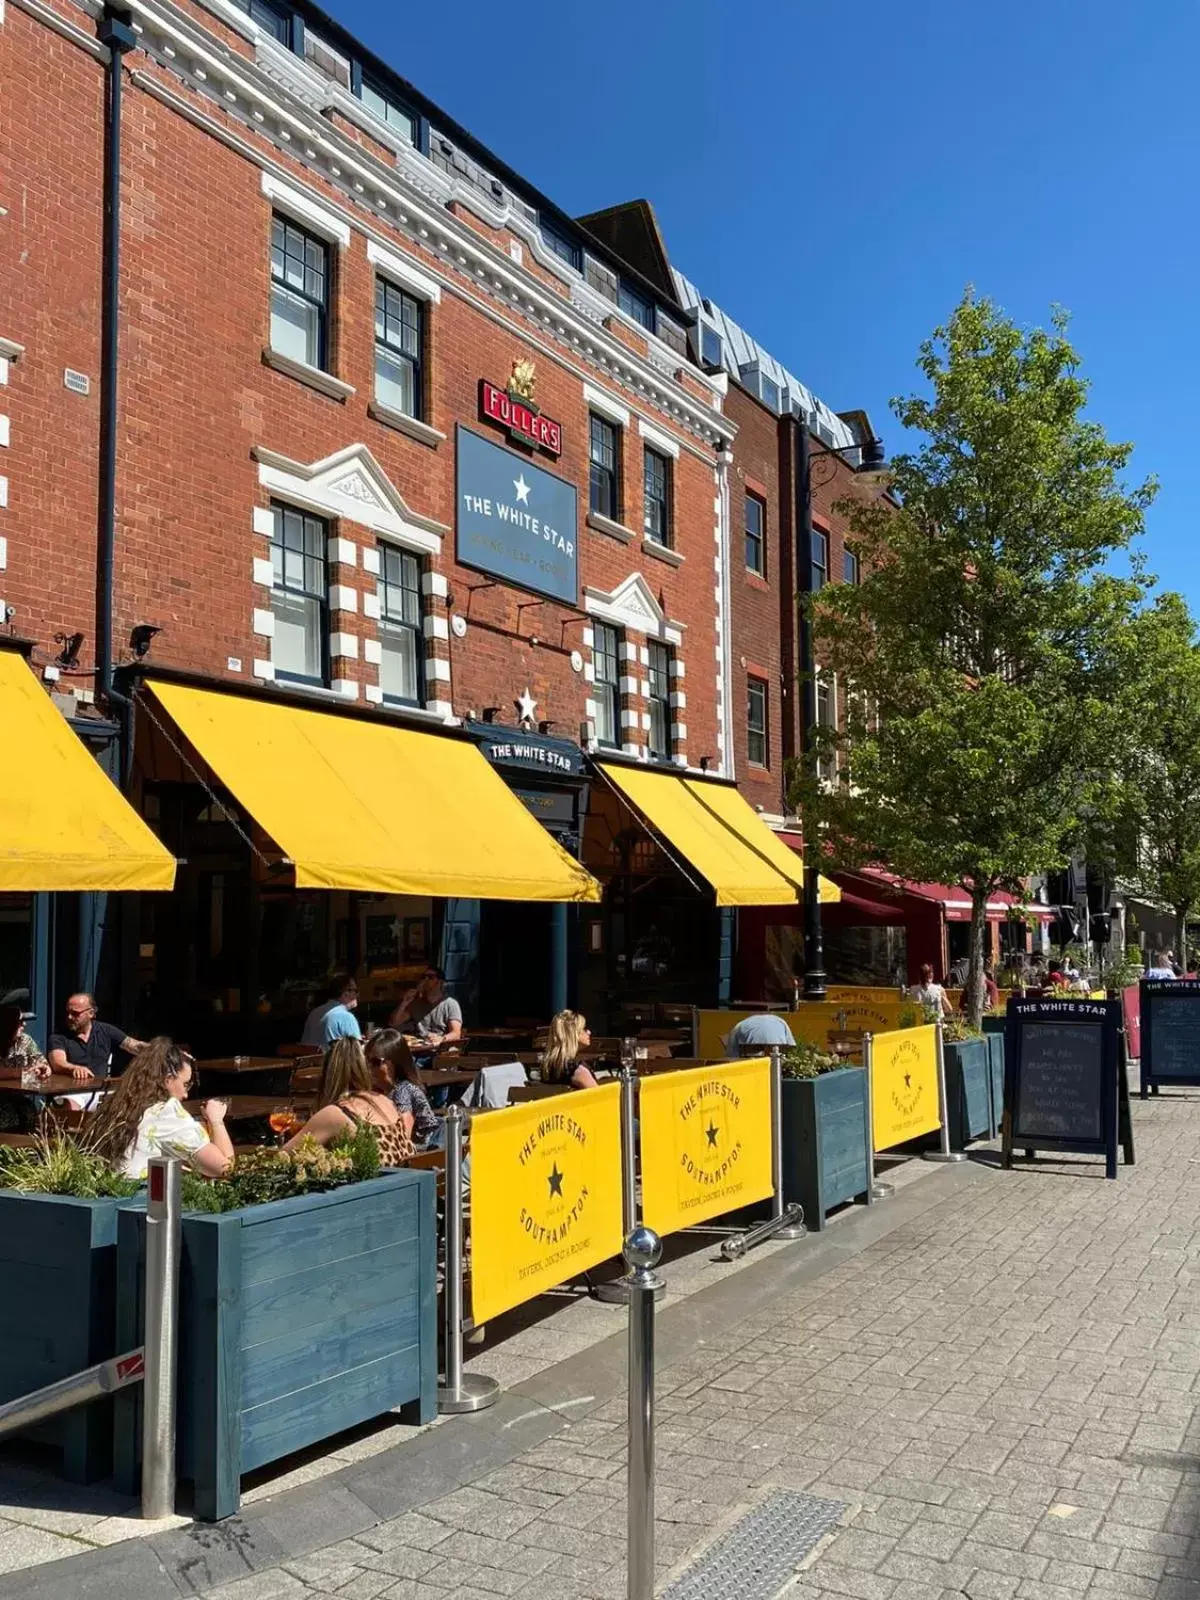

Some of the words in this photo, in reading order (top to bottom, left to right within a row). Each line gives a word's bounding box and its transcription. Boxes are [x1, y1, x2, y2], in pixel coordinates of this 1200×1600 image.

[464, 494, 492, 516] THE
[496, 502, 539, 535] WHITE
[543, 525, 574, 558] STAR
[491, 744, 512, 758] THE
[514, 745, 545, 761] WHITE
[547, 751, 572, 771] STAR
[1016, 1003, 1037, 1014] THE
[1040, 1002, 1075, 1012] WHITE
[1078, 1004, 1107, 1016] STAR
[680, 1095, 697, 1121] THE
[697, 1081, 720, 1101] WHITE
[720, 1084, 740, 1110] STAR
[519, 1133, 537, 1167] THE
[537, 1114, 564, 1139] WHITE
[567, 1117, 587, 1150] STAR
[680, 1141, 742, 1186] SOUTHAMPTON
[519, 1184, 590, 1246] SOUTHAMPTON
